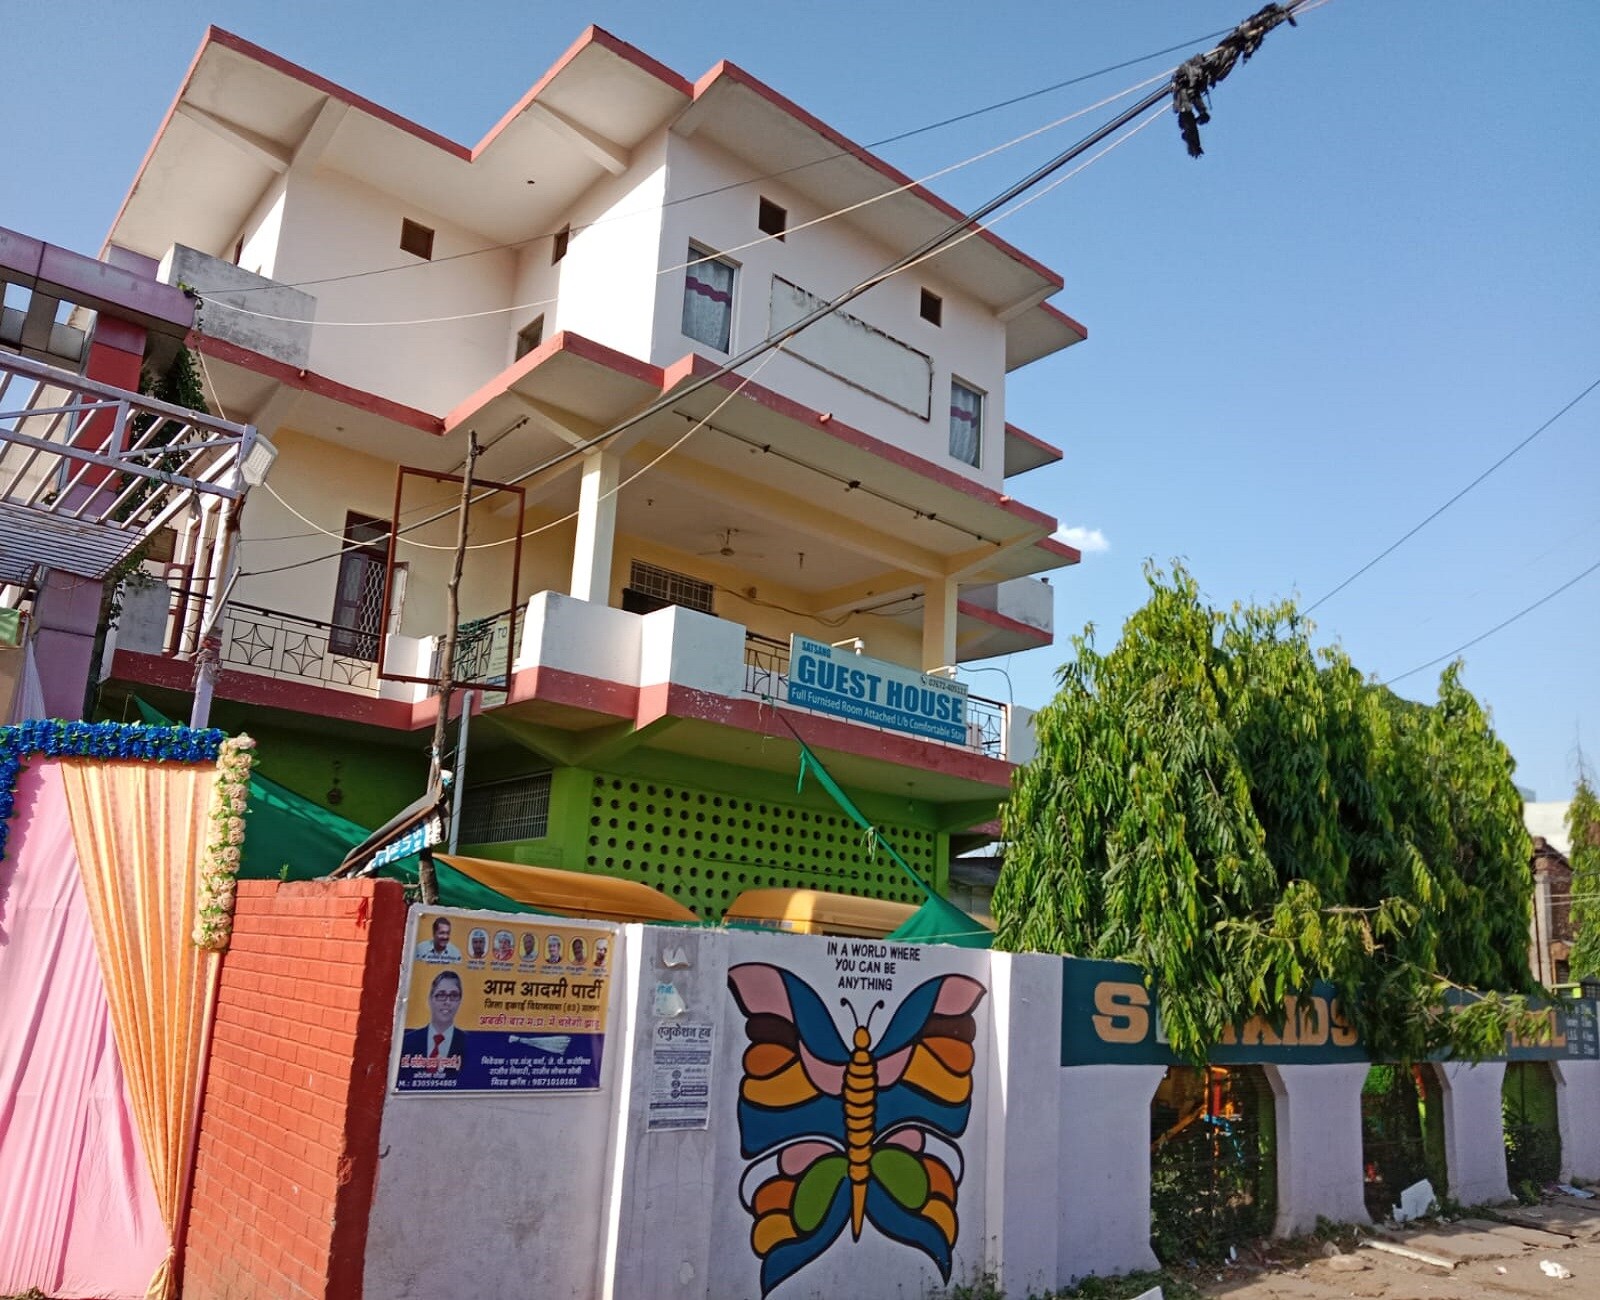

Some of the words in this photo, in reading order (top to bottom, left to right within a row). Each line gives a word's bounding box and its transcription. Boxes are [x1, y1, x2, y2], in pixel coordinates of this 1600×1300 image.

[802, 641, 831, 658] SATSANG
[797, 655, 881, 702] GUEST
[887, 680, 963, 723] HOUSE
[791, 687, 807, 701] Full
[808, 691, 841, 710] Furnised
[842, 699, 863, 716] Room
[864, 703, 896, 724] Attached
[909, 718, 951, 737] Comfortable
[951, 727, 966, 742] Stay
[827, 941, 838, 956] IN
[841, 943, 849, 957] A
[851, 943, 887, 958] WORLD
[890, 946, 921, 961] WHERE
[835, 958, 855, 972] YOU
[859, 961, 881, 974] CAN
[884, 962, 896, 974] BE
[483, 979, 516, 996] आम
[520, 977, 568, 998] आदमी
[571, 978, 604, 999] पार्टी
[838, 976, 893, 991] ANYTHING
[484, 997, 503, 1009] जिला
[504, 999, 527, 1011] इकाई
[479, 1014, 506, 1025] अबकी
[510, 1016, 525, 1026] बार
[548, 1016, 556, 1026] में
[657, 1023, 697, 1042] एजुकेशन
[698, 1025, 712, 1039] हब
